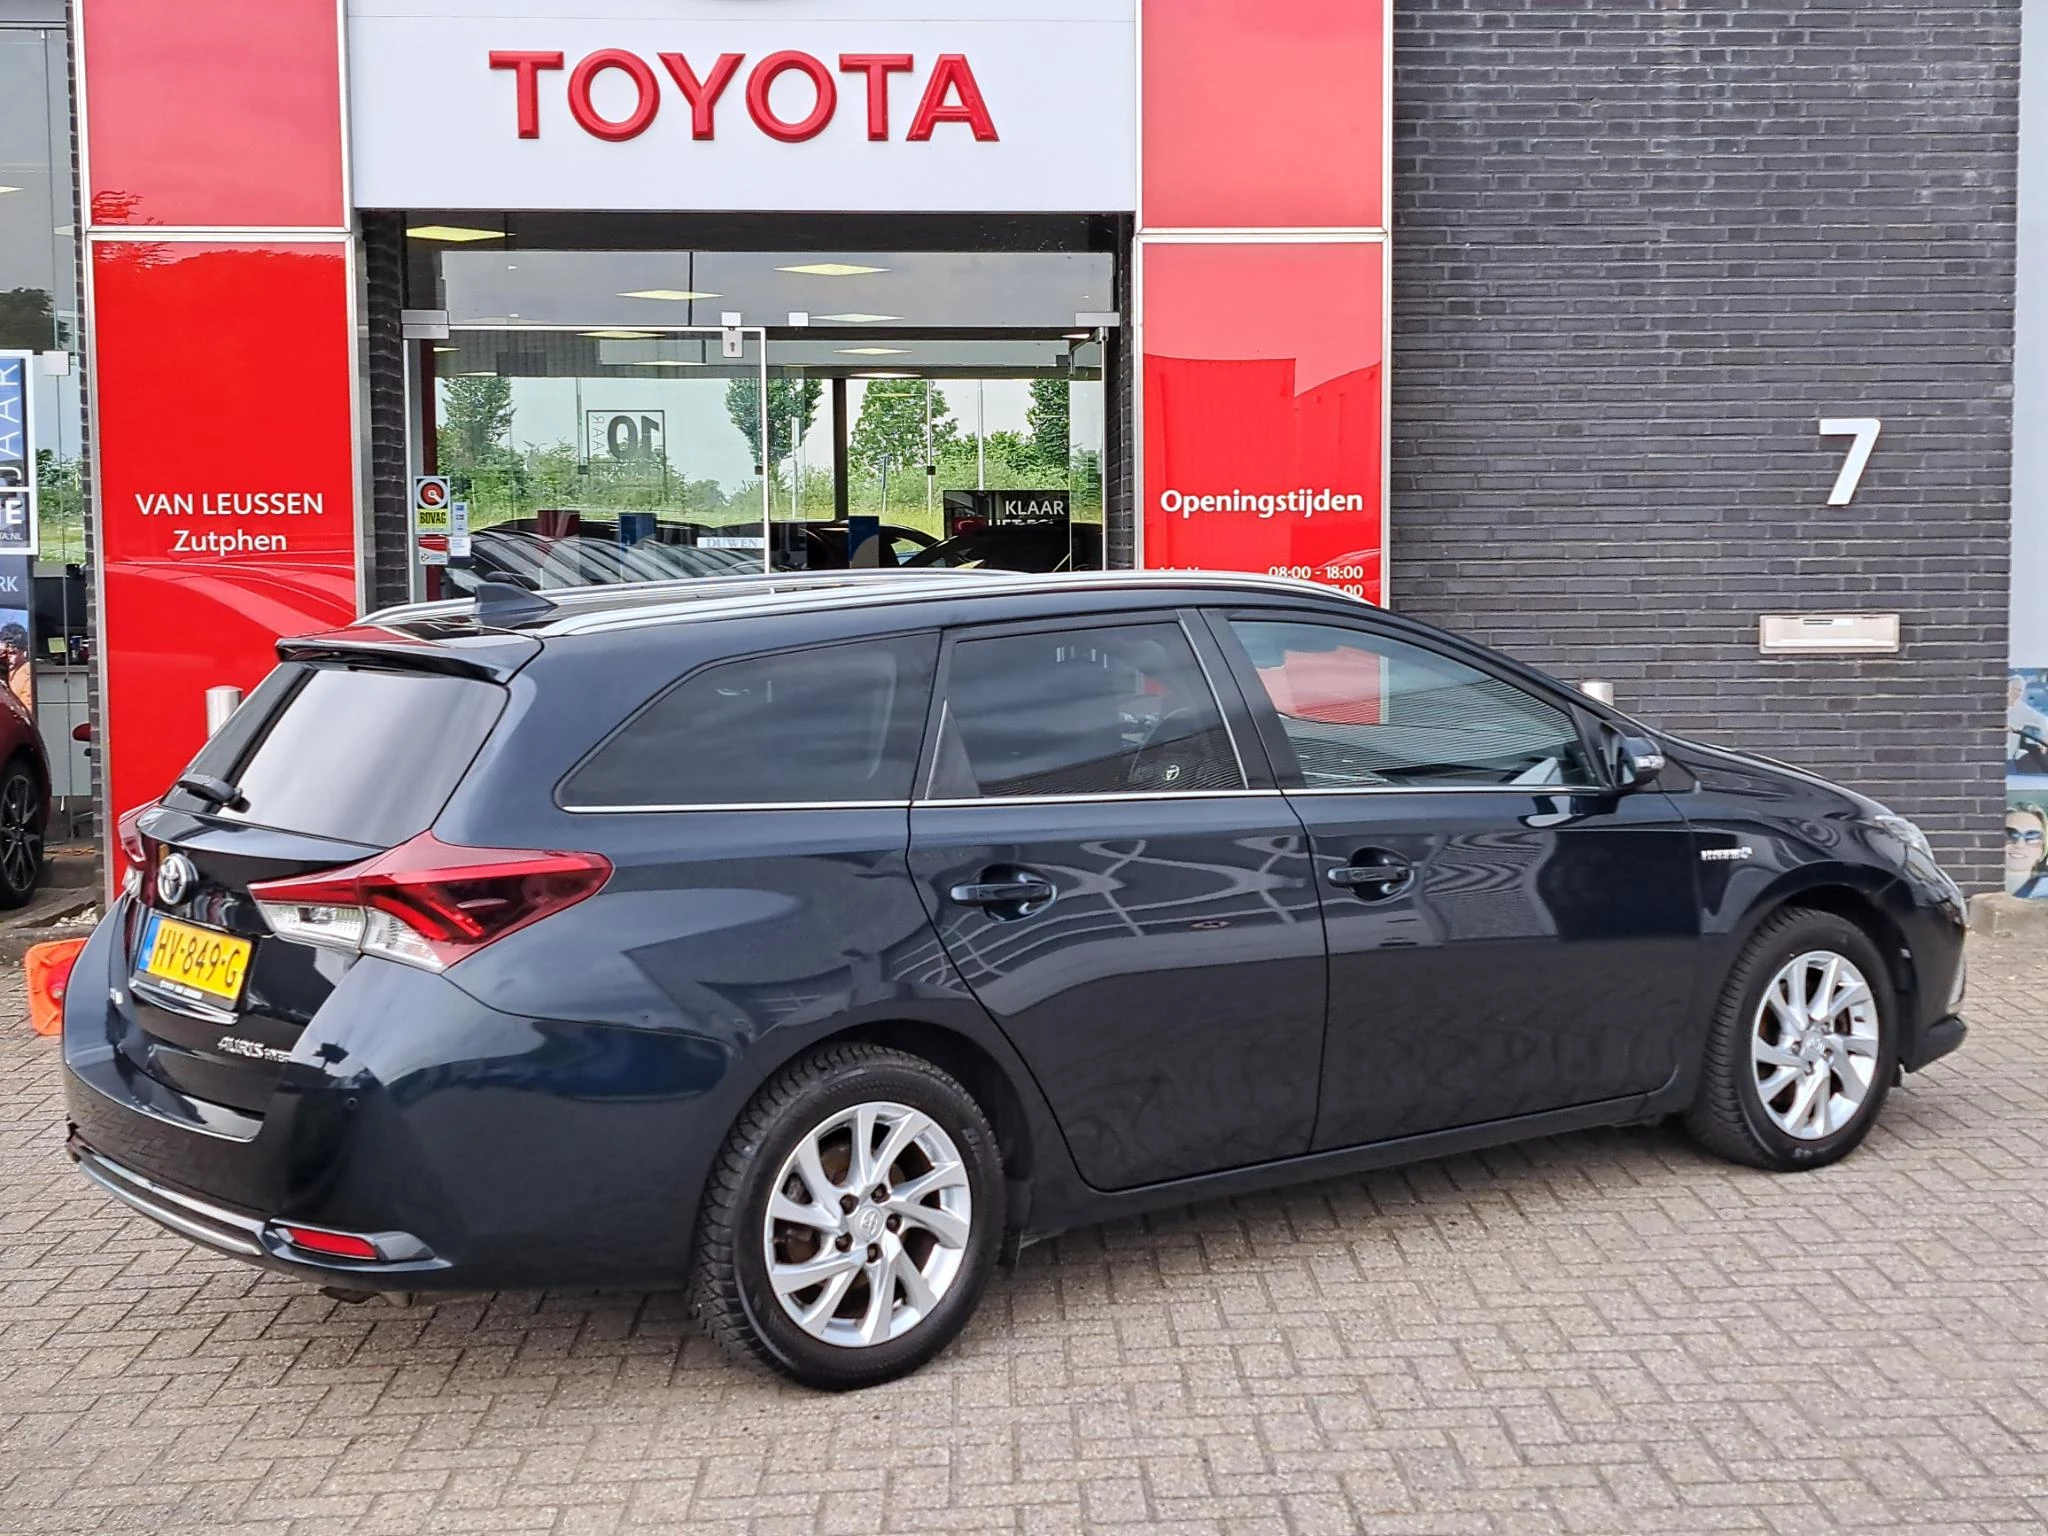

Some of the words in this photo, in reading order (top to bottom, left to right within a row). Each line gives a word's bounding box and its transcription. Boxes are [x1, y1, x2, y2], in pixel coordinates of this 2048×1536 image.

[488, 48, 1001, 143] TOYOTA
[1819, 418, 1881, 506] 7
[135, 493, 194, 515] VAN
[202, 493, 323, 515] LEUSSEN
[1005, 500, 1065, 515] KLAAR
[1160, 488, 1363, 518] Openingstijden
[420, 512, 447, 524] BOVAG
[173, 529, 287, 556] Zutphen
[1268, 566, 1312, 579] 08:00
[1325, 565, 1364, 579] 18:00
[152, 927, 241, 988] HV-849-G
[217, 1036, 264, 1058] AURIS
